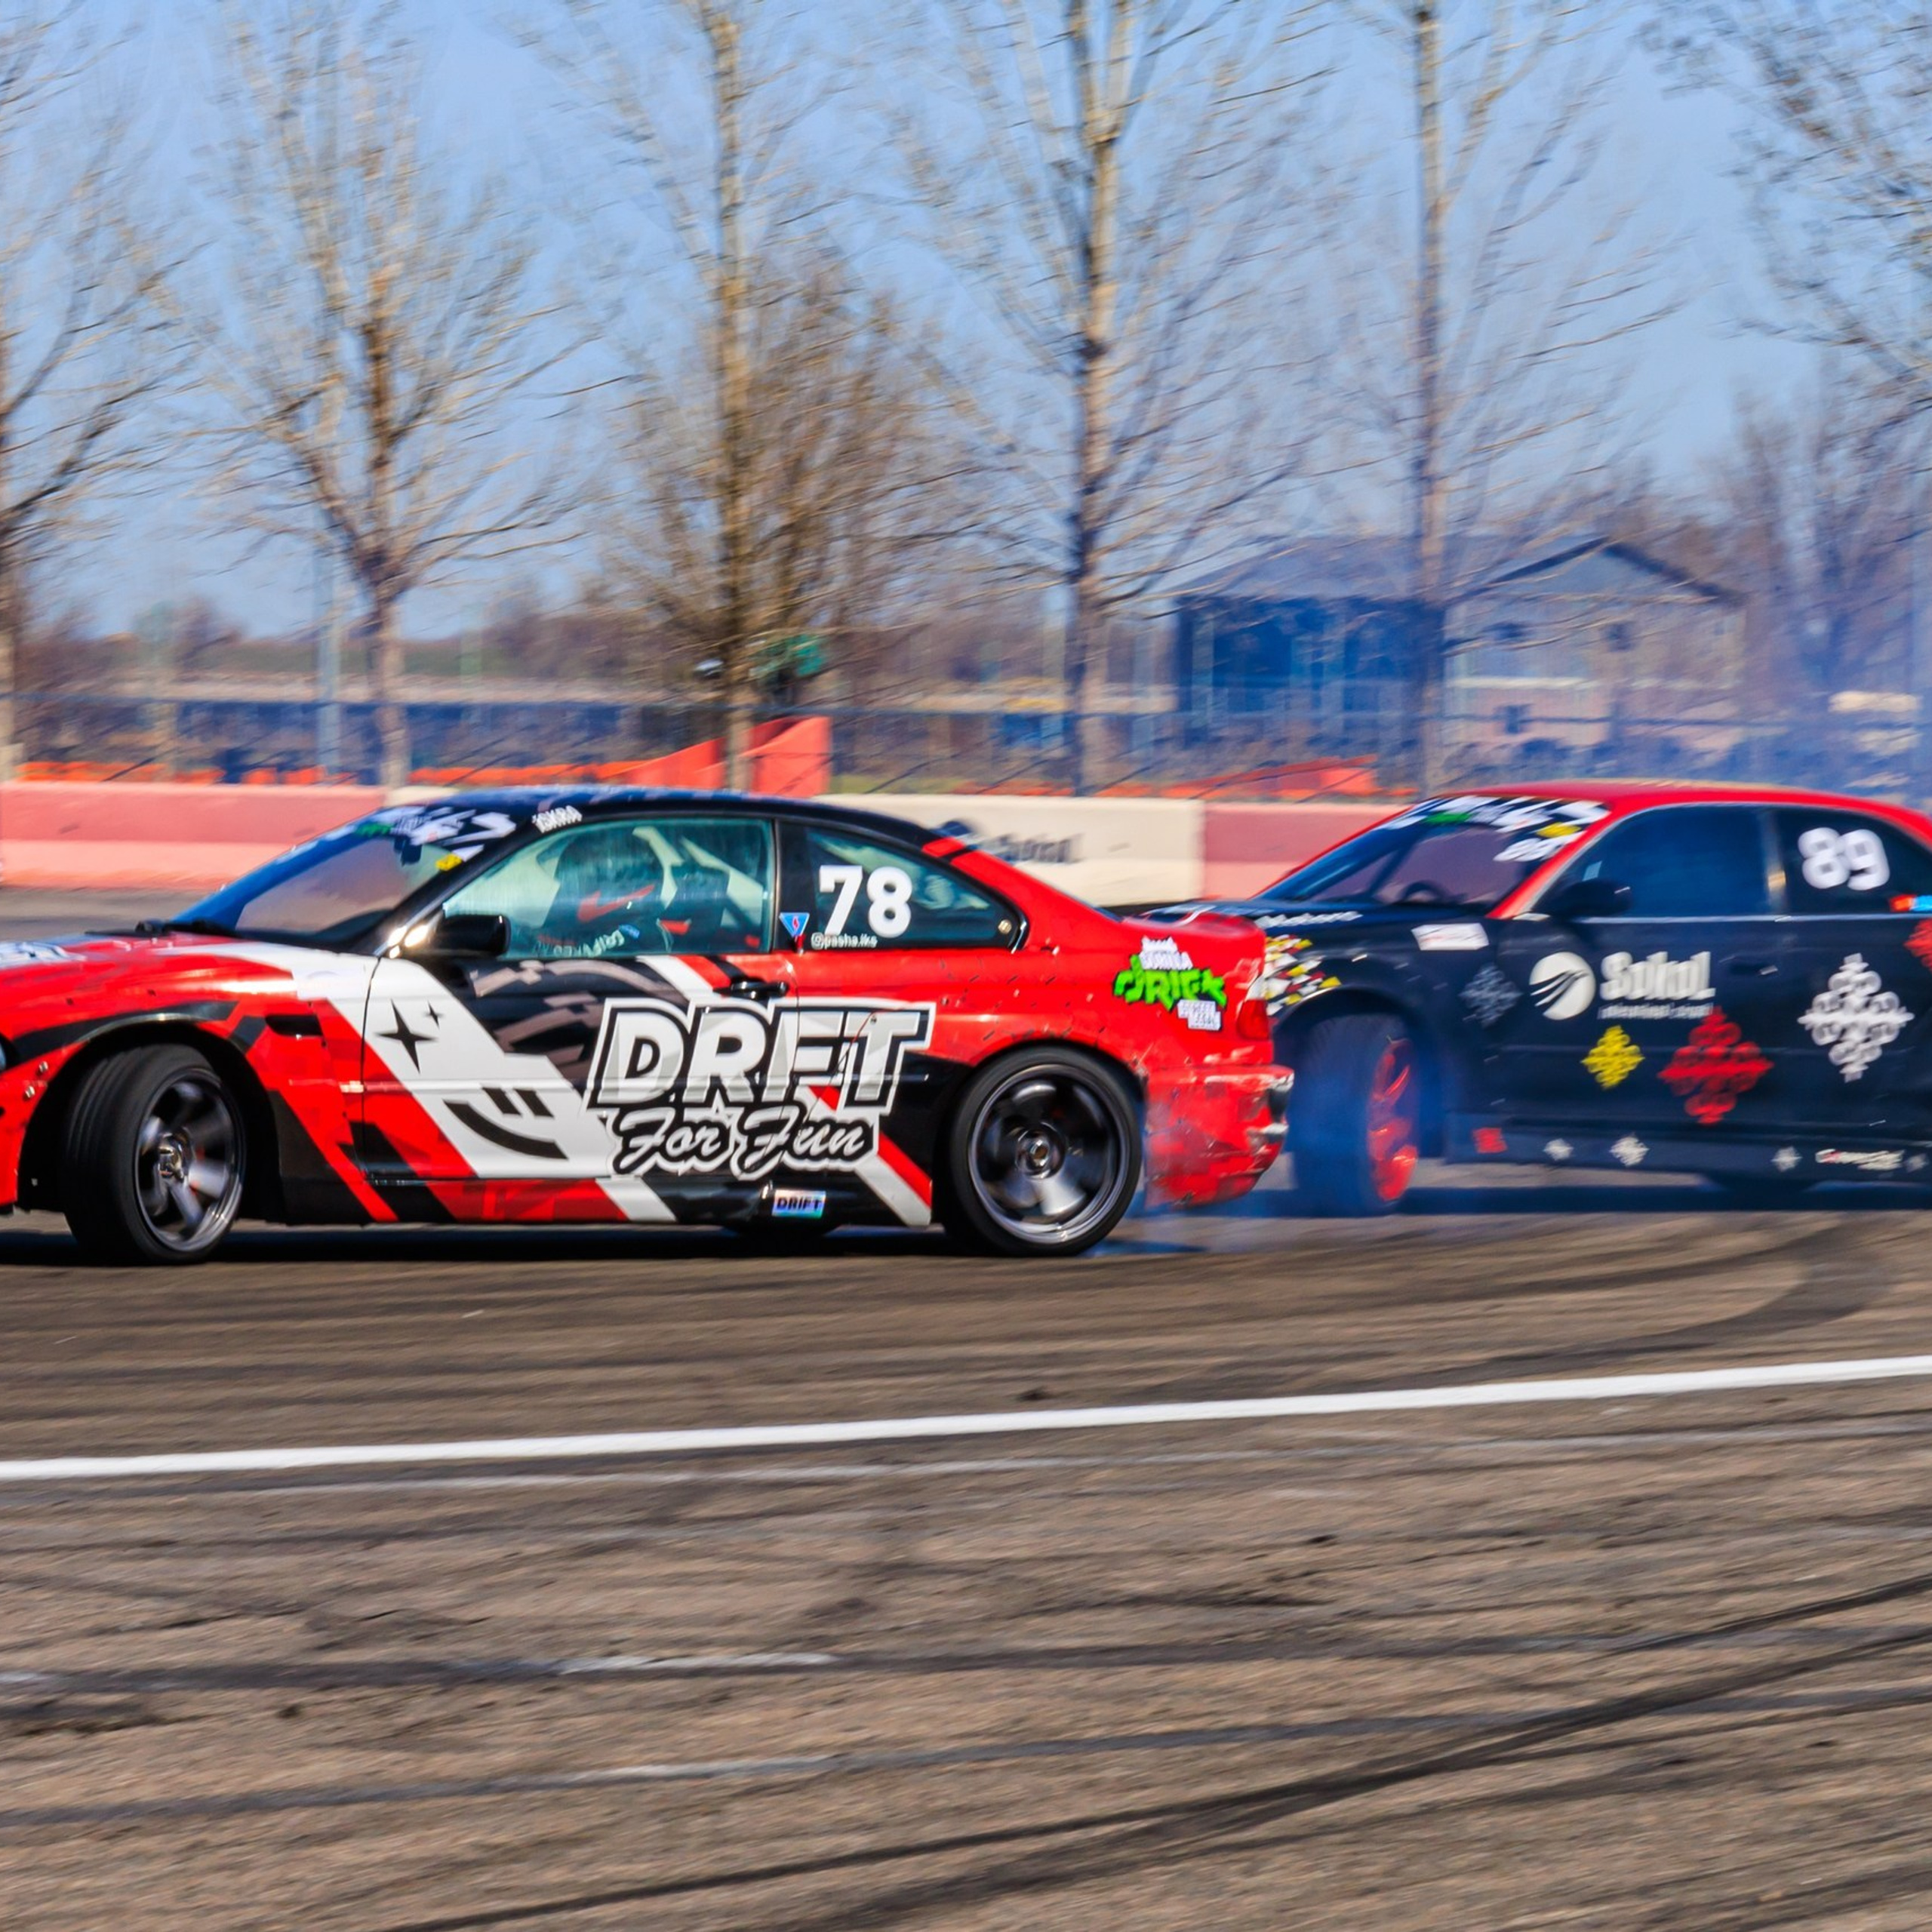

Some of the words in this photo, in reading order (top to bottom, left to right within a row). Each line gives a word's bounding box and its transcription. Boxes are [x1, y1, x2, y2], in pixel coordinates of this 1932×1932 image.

[1798, 827, 1890, 891] 89
[819, 865, 912, 938] 78
[614, 1105, 726, 1174] For
[738, 1105, 869, 1177] Fun
[777, 1196, 822, 1212] DRIFT
